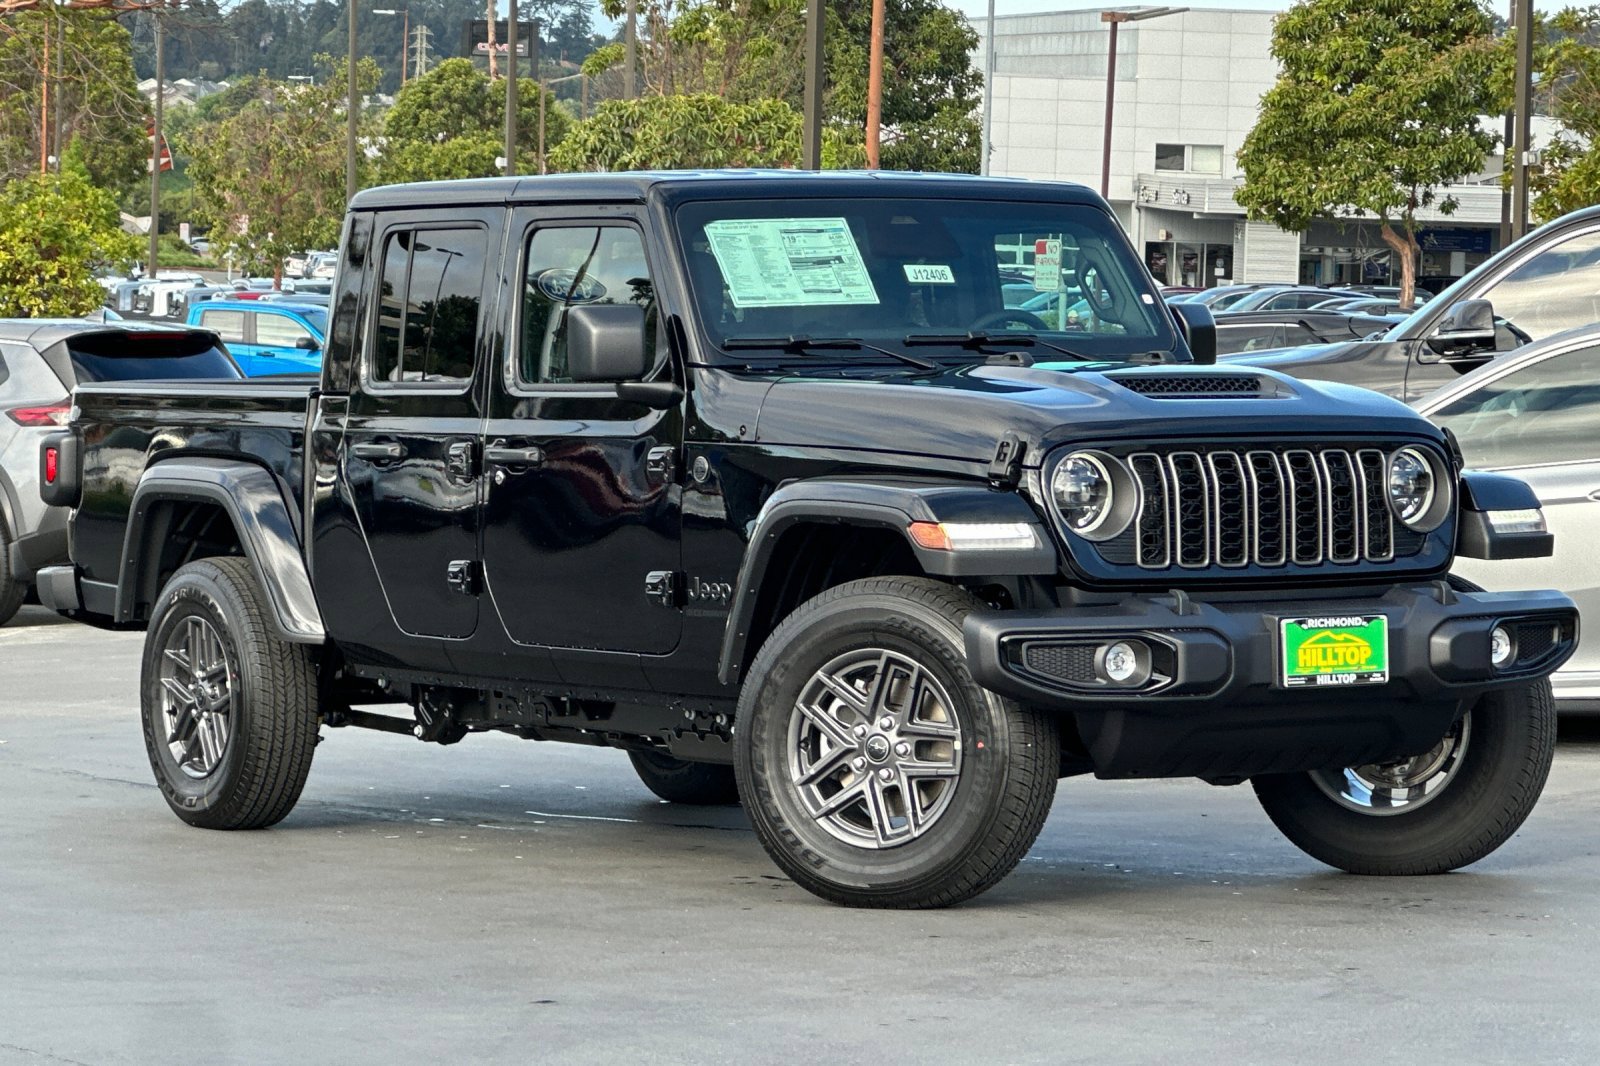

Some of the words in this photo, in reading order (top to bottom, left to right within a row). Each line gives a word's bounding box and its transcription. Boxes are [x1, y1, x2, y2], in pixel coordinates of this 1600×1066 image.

[1048, 245, 1058, 255] NO
[912, 268, 948, 281] J12406
[689, 576, 731, 606] Jeep
[1307, 617, 1362, 628] RICHMOND
[1298, 646, 1371, 667] HILLTOP
[1317, 673, 1357, 685] HILLTOP
